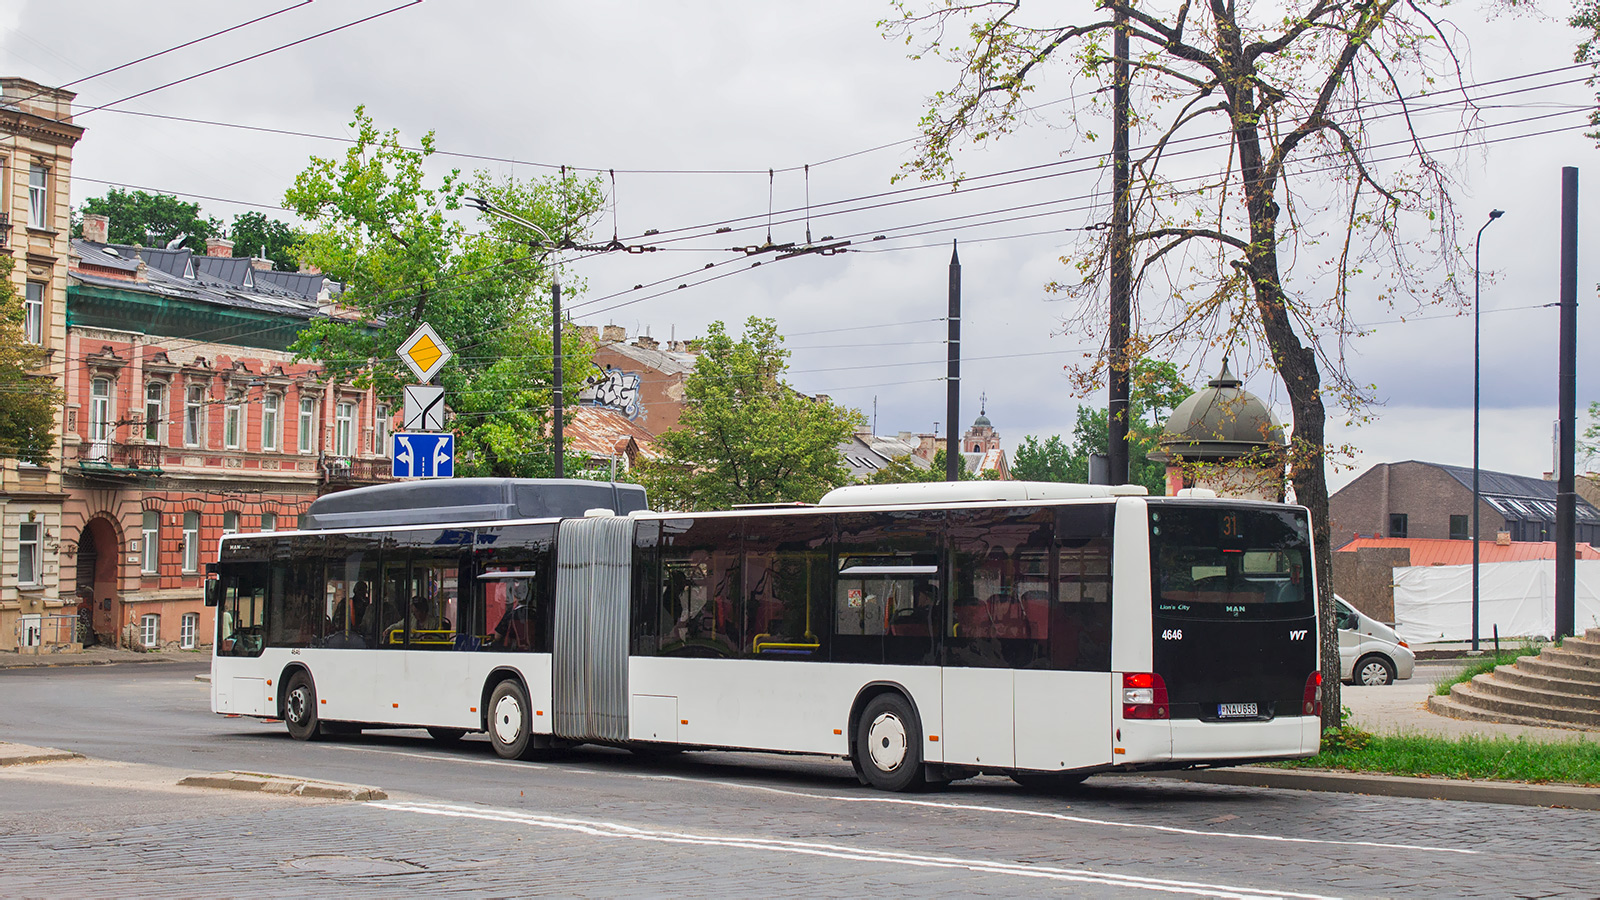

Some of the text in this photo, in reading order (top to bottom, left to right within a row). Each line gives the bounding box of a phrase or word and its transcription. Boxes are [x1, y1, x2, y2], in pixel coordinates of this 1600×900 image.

[1223, 515, 1236, 535] 31
[1177, 603, 1191, 611] City
[1161, 629, 1183, 640] 4646
